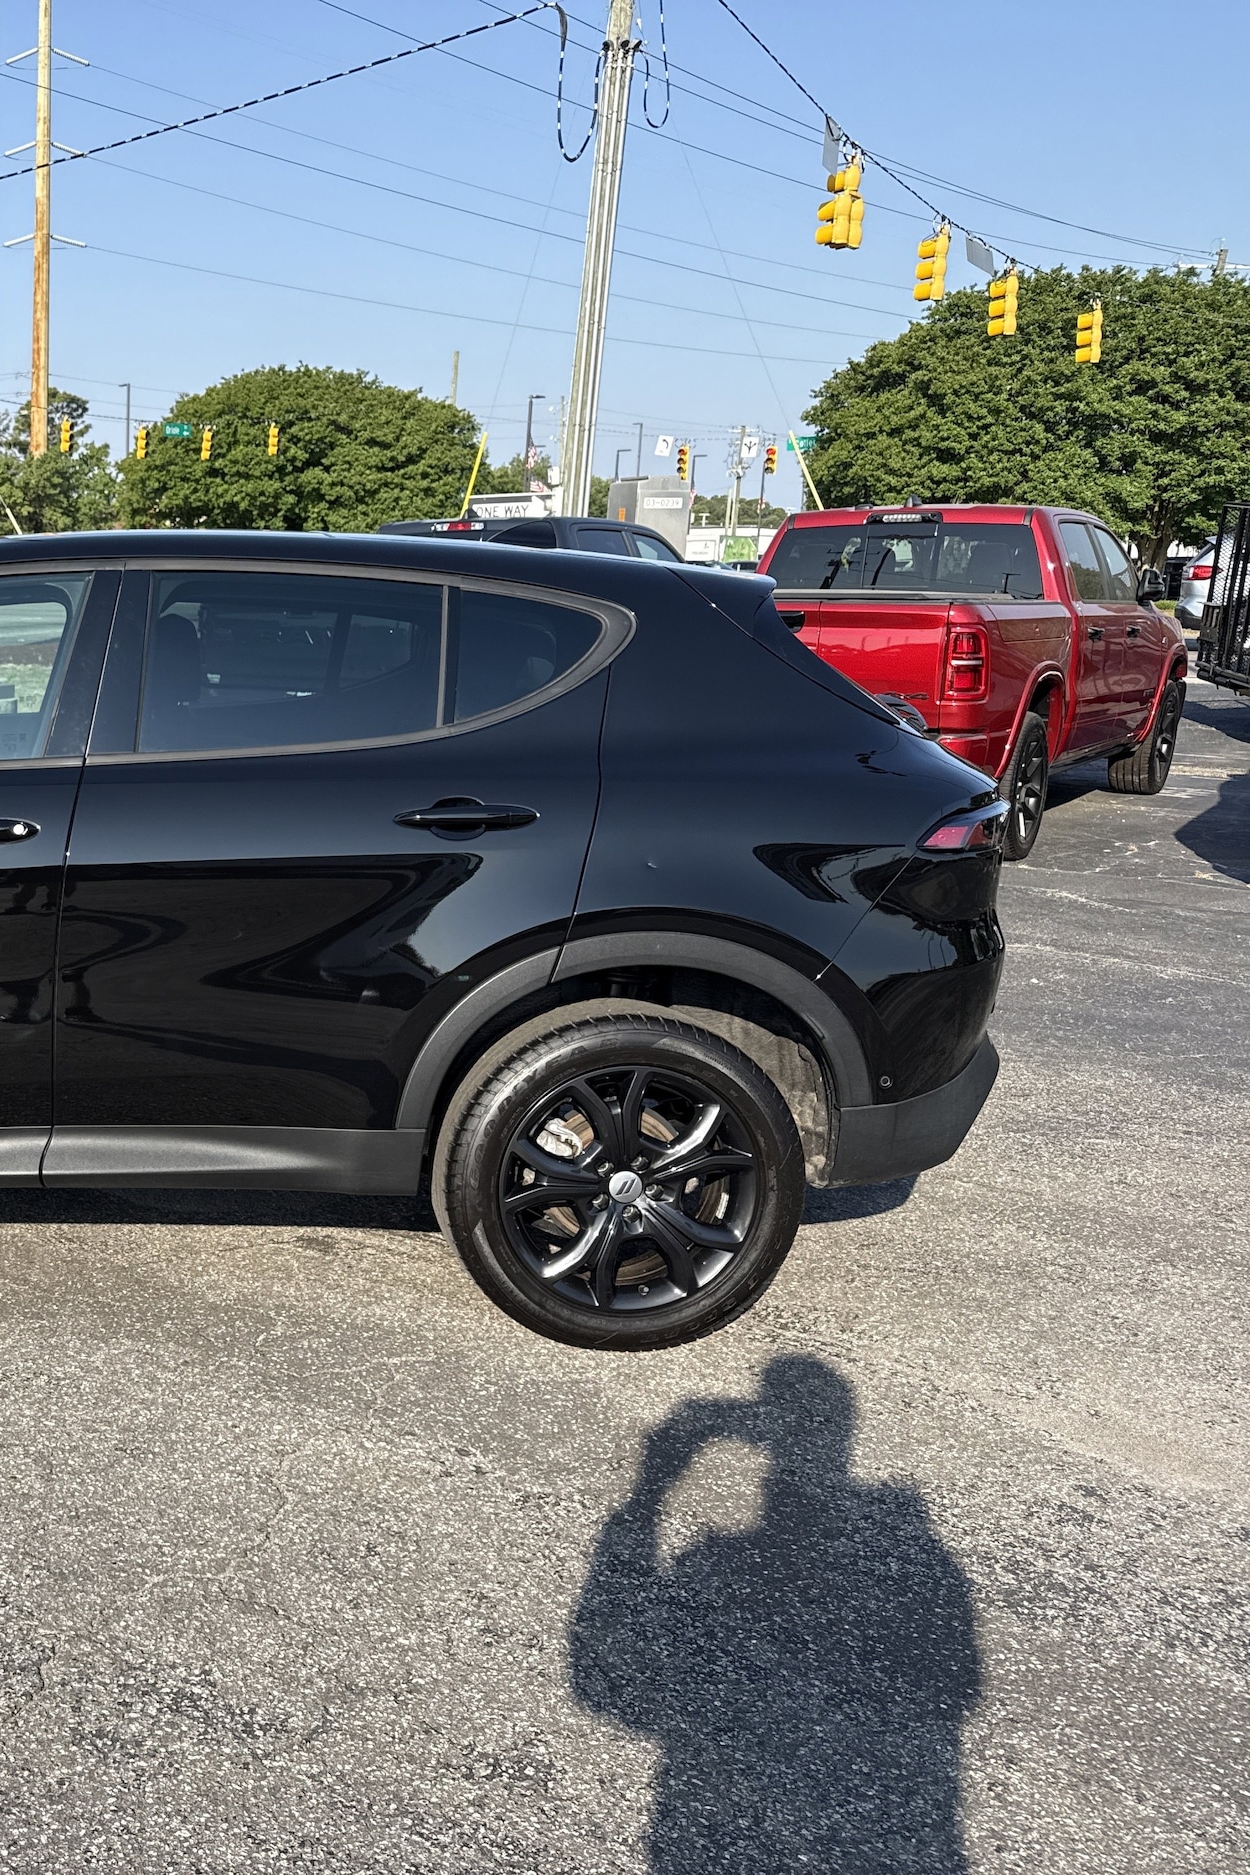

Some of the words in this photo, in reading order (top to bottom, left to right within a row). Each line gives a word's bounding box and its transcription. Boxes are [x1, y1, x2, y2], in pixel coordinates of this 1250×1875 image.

[645, 499, 680, 507] 03-0239
[477, 505, 499, 518] ONE
[504, 504, 529, 518] WAY
[470, 1037, 621, 1190] GOODYEAR
